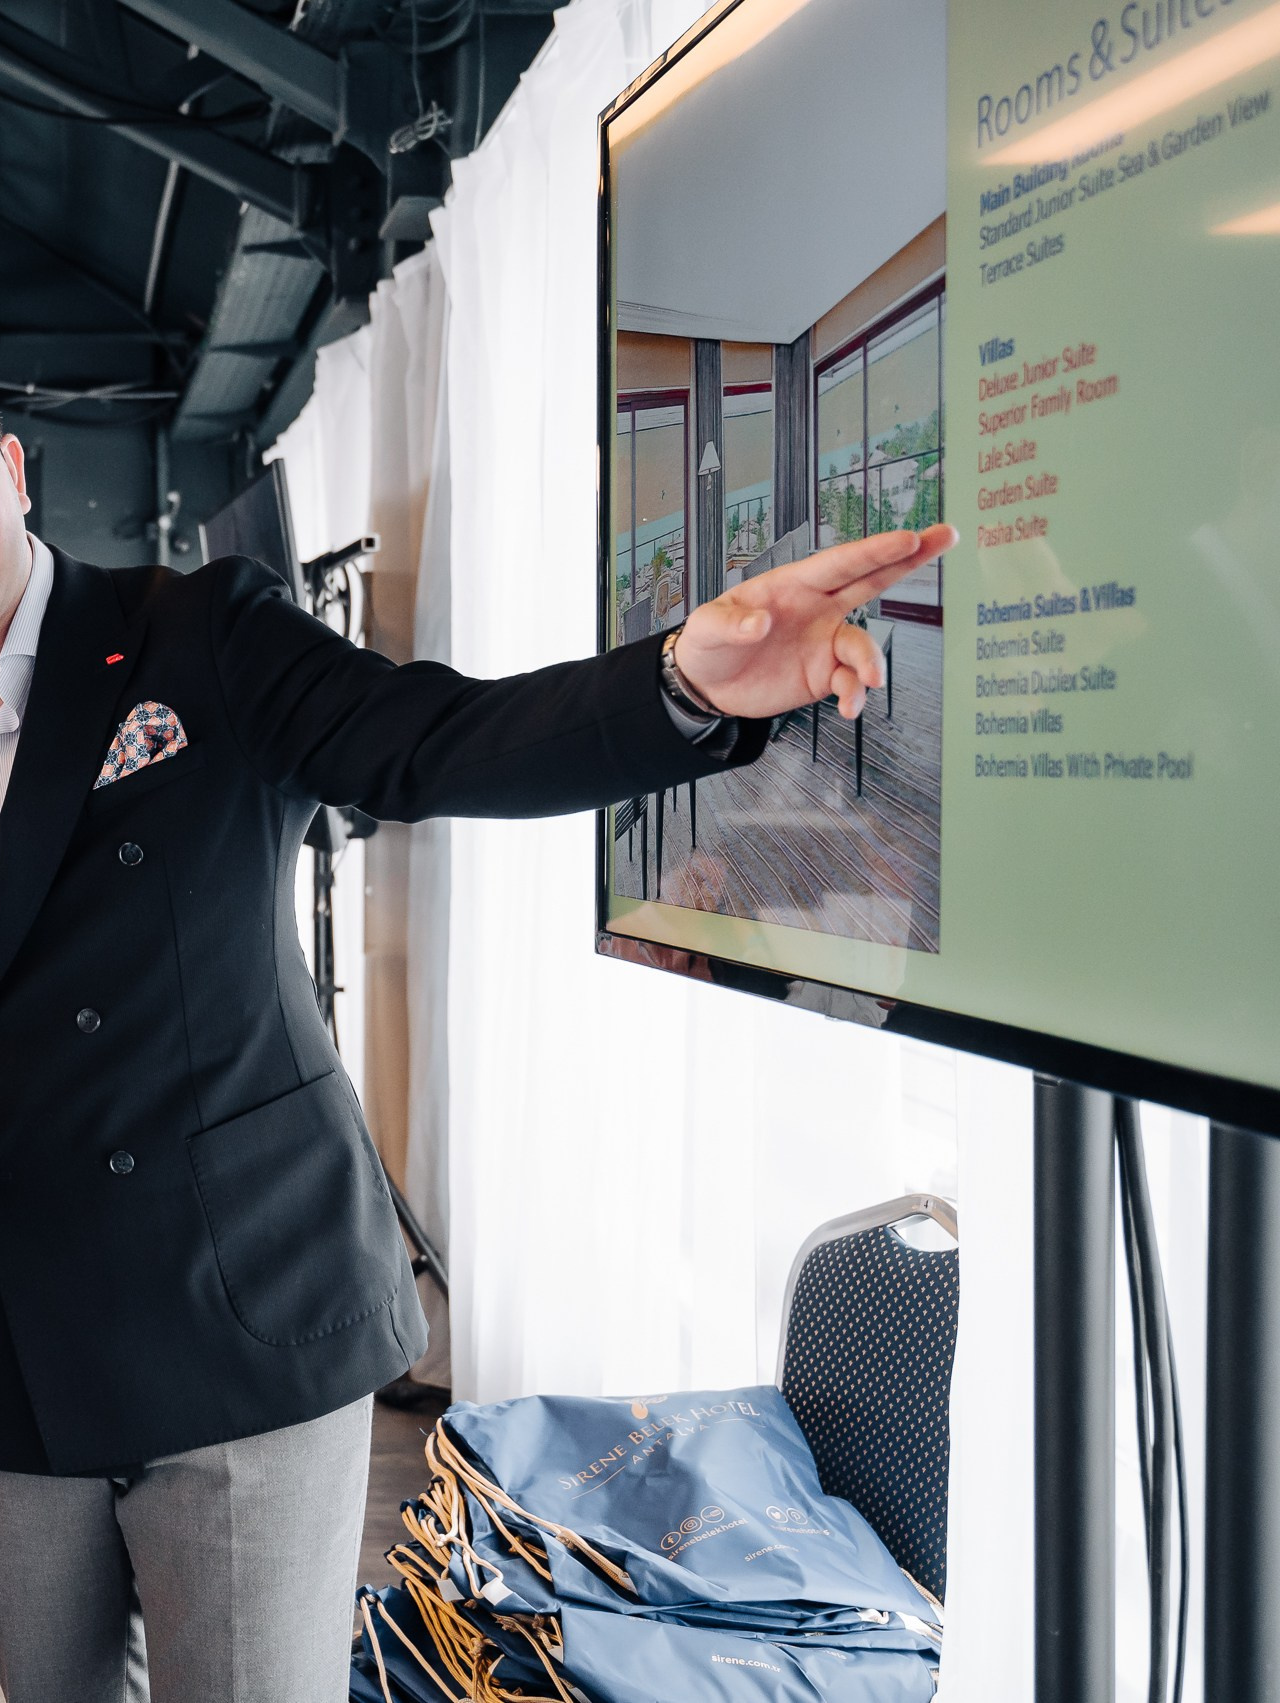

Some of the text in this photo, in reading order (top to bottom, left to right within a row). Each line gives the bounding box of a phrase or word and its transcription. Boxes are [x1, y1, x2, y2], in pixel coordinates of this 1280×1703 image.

[977, 0, 1233, 149] Rooms & Suit
[979, 90, 1271, 250] Standard Junior Suite Sea & Garden View
[979, 184, 1011, 217] Main
[1012, 160, 1069, 200] Building
[979, 232, 1065, 288] Terrace Suites
[978, 336, 1015, 367] Villas
[978, 342, 1098, 402] Deluxe Junior Suite
[978, 373, 1119, 437] Superior Family Room
[978, 439, 1037, 474] Lale Suite
[977, 472, 1059, 511] Garden Suite
[977, 515, 1049, 548] Pasha Suite
[976, 580, 1136, 626] Bohemia Suites & Villas
[976, 628, 1065, 660] Bohemia Suite
[976, 671, 1029, 698] Bohemia
[1079, 665, 1116, 691] Suite
[975, 708, 1064, 735] Bohemia Villas
[975, 751, 1194, 779] Bohemia Villas With Private Pool
[558, 1401, 761, 1490] SIRENE BELEK HOTEL
[631, 1424, 711, 1464] ANTALYA
[744, 1543, 800, 1562] sirene.co
[711, 1653, 782, 1673] sirene.com.tr
